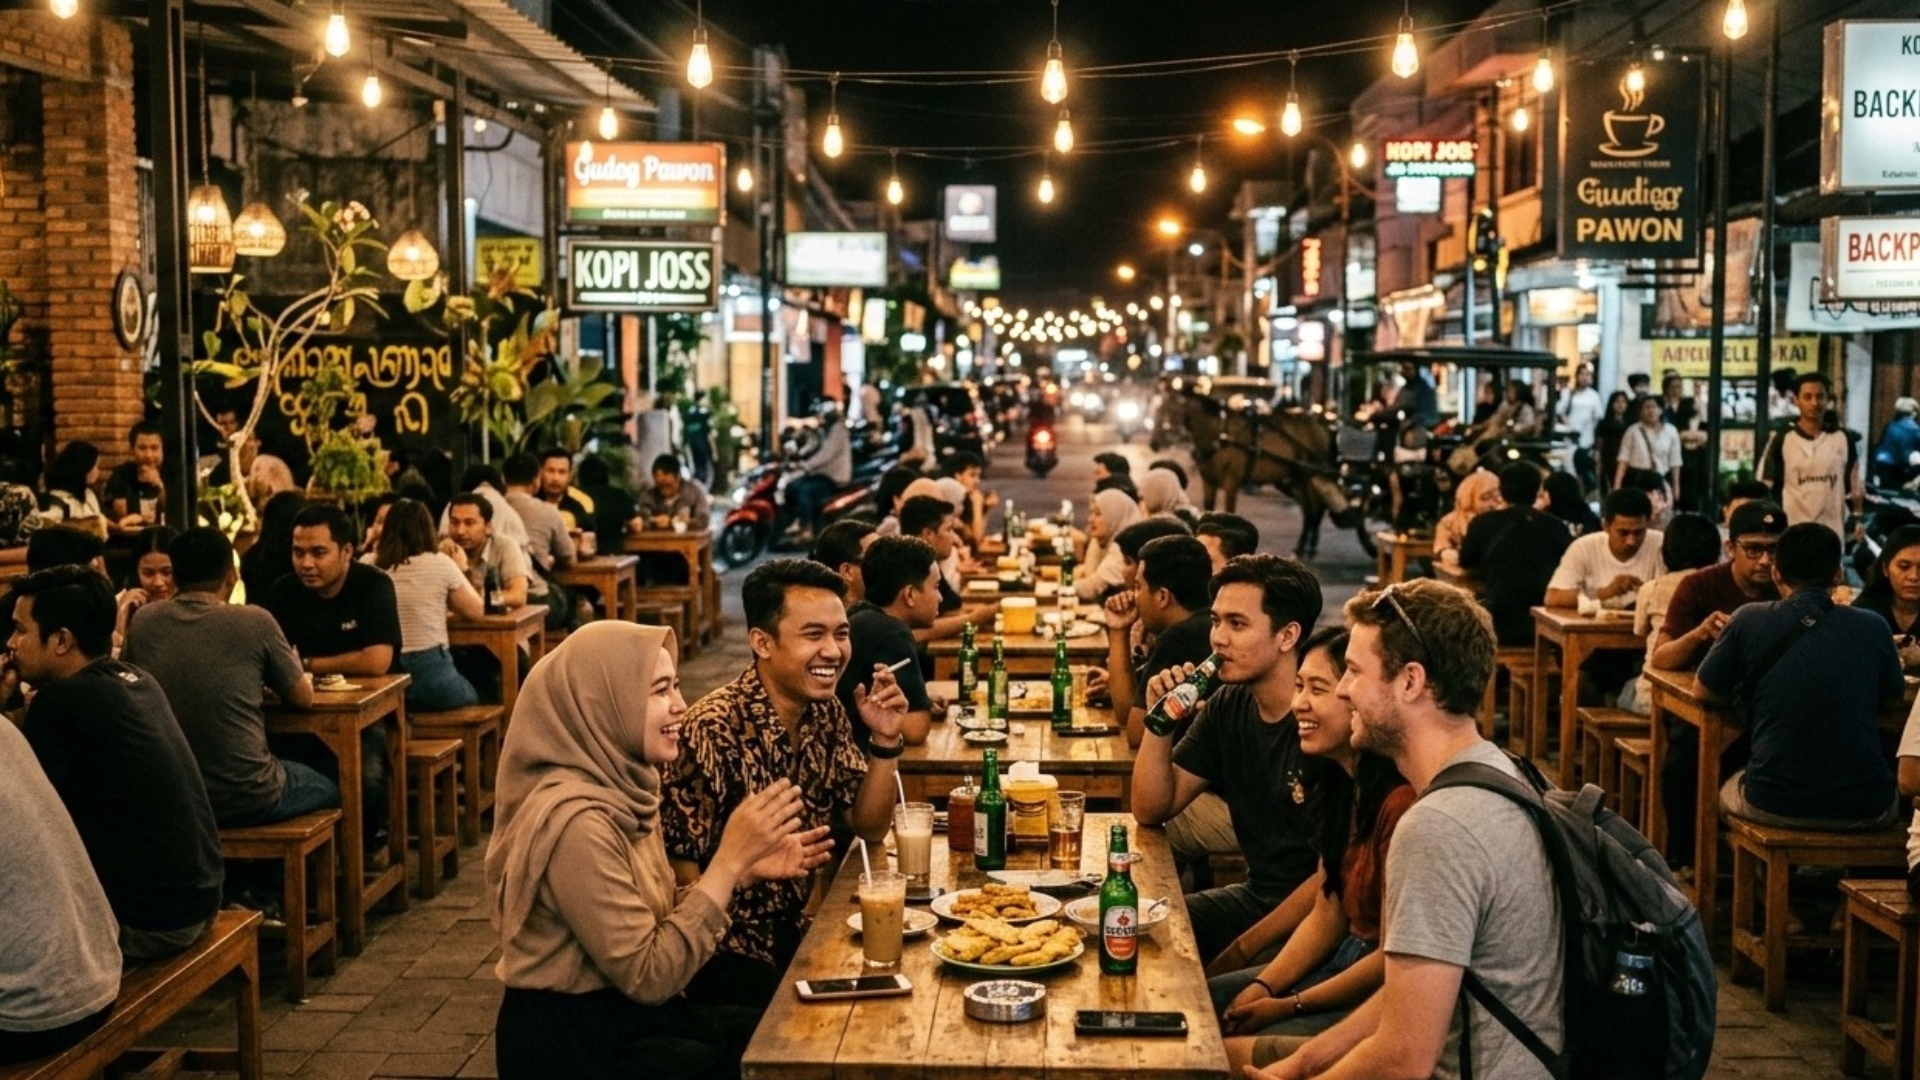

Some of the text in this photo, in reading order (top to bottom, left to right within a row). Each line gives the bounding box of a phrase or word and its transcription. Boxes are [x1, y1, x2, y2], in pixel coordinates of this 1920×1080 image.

[1854, 89, 1920, 119] BACK
[1577, 217, 1683, 242] PAWON
[575, 250, 640, 289] KOPI
[644, 251, 711, 290] JOSS
